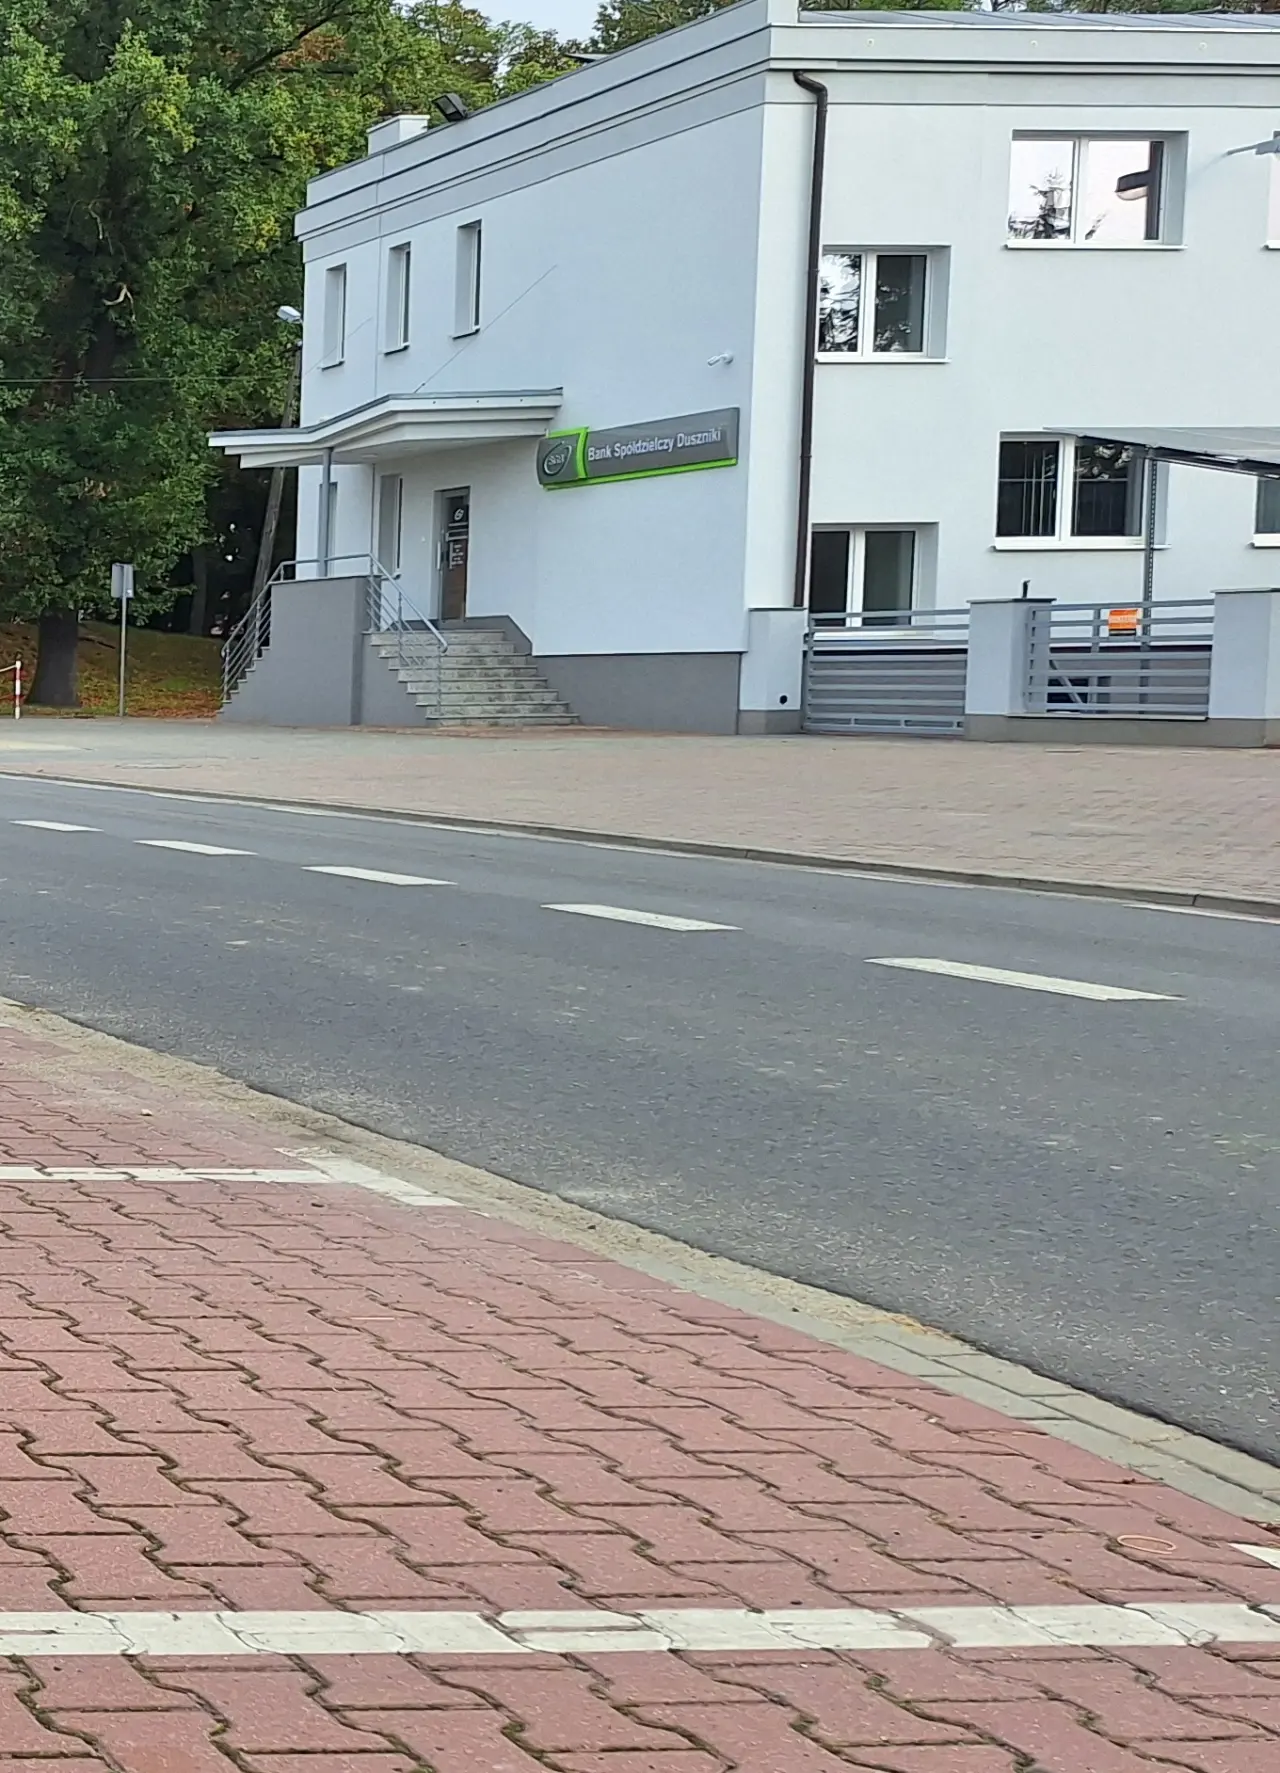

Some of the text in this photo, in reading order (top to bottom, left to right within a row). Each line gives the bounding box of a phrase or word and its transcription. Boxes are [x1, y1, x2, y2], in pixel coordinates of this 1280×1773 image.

[587, 446, 611, 461] Bank
[613, 436, 674, 460] Spółdzielczy
[676, 428, 721, 447] Duszniki
